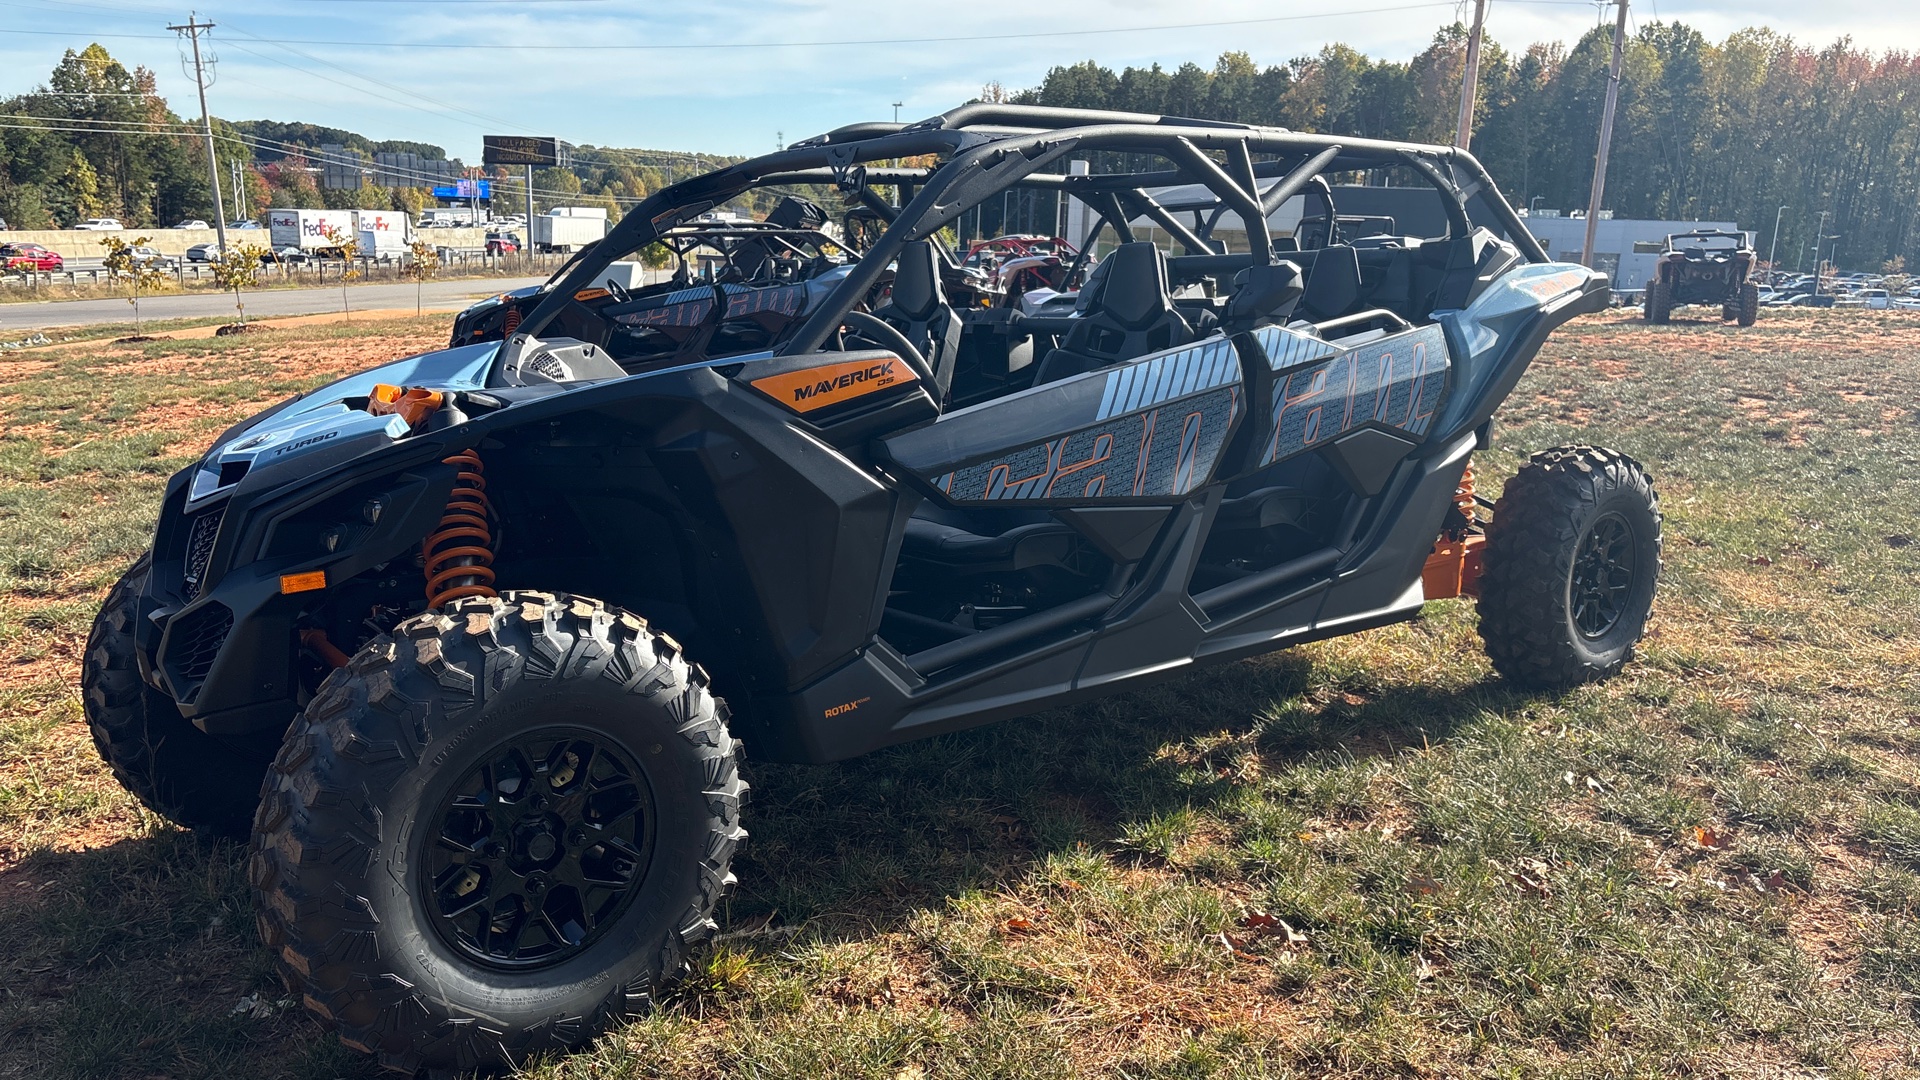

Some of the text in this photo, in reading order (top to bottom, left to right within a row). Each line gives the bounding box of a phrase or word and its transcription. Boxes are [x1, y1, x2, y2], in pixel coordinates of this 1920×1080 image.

[272, 217, 297, 227] FedEx
[793, 361, 894, 402] MAVERICK
[877, 376, 895, 387] DS
[274, 431, 338, 456] TURBO
[824, 700, 858, 719] ROTAX
